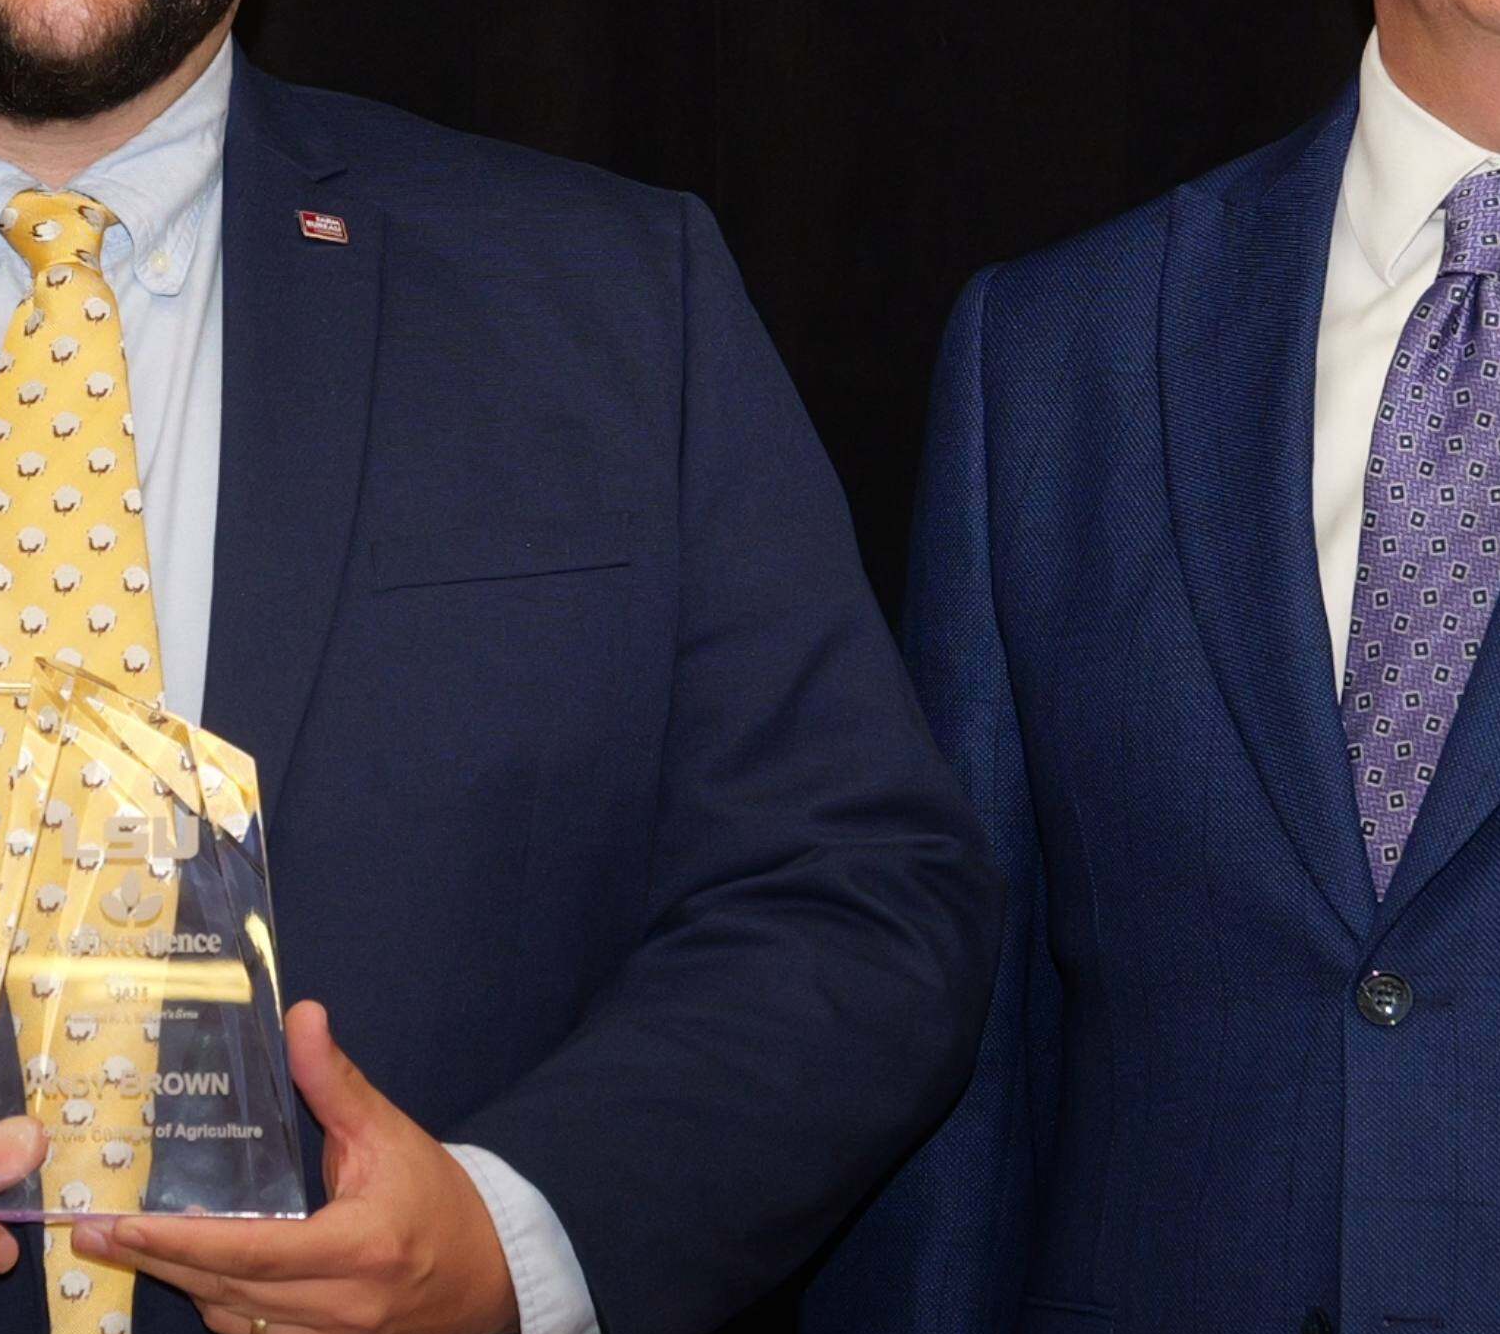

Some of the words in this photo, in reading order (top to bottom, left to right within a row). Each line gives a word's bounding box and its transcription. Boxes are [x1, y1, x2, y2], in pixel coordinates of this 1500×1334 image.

[61, 816, 199, 859] LSU
[120, 1072, 229, 1096] BROWN
[155, 1123, 172, 1138] of
[174, 1124, 263, 1141] Agriculture
